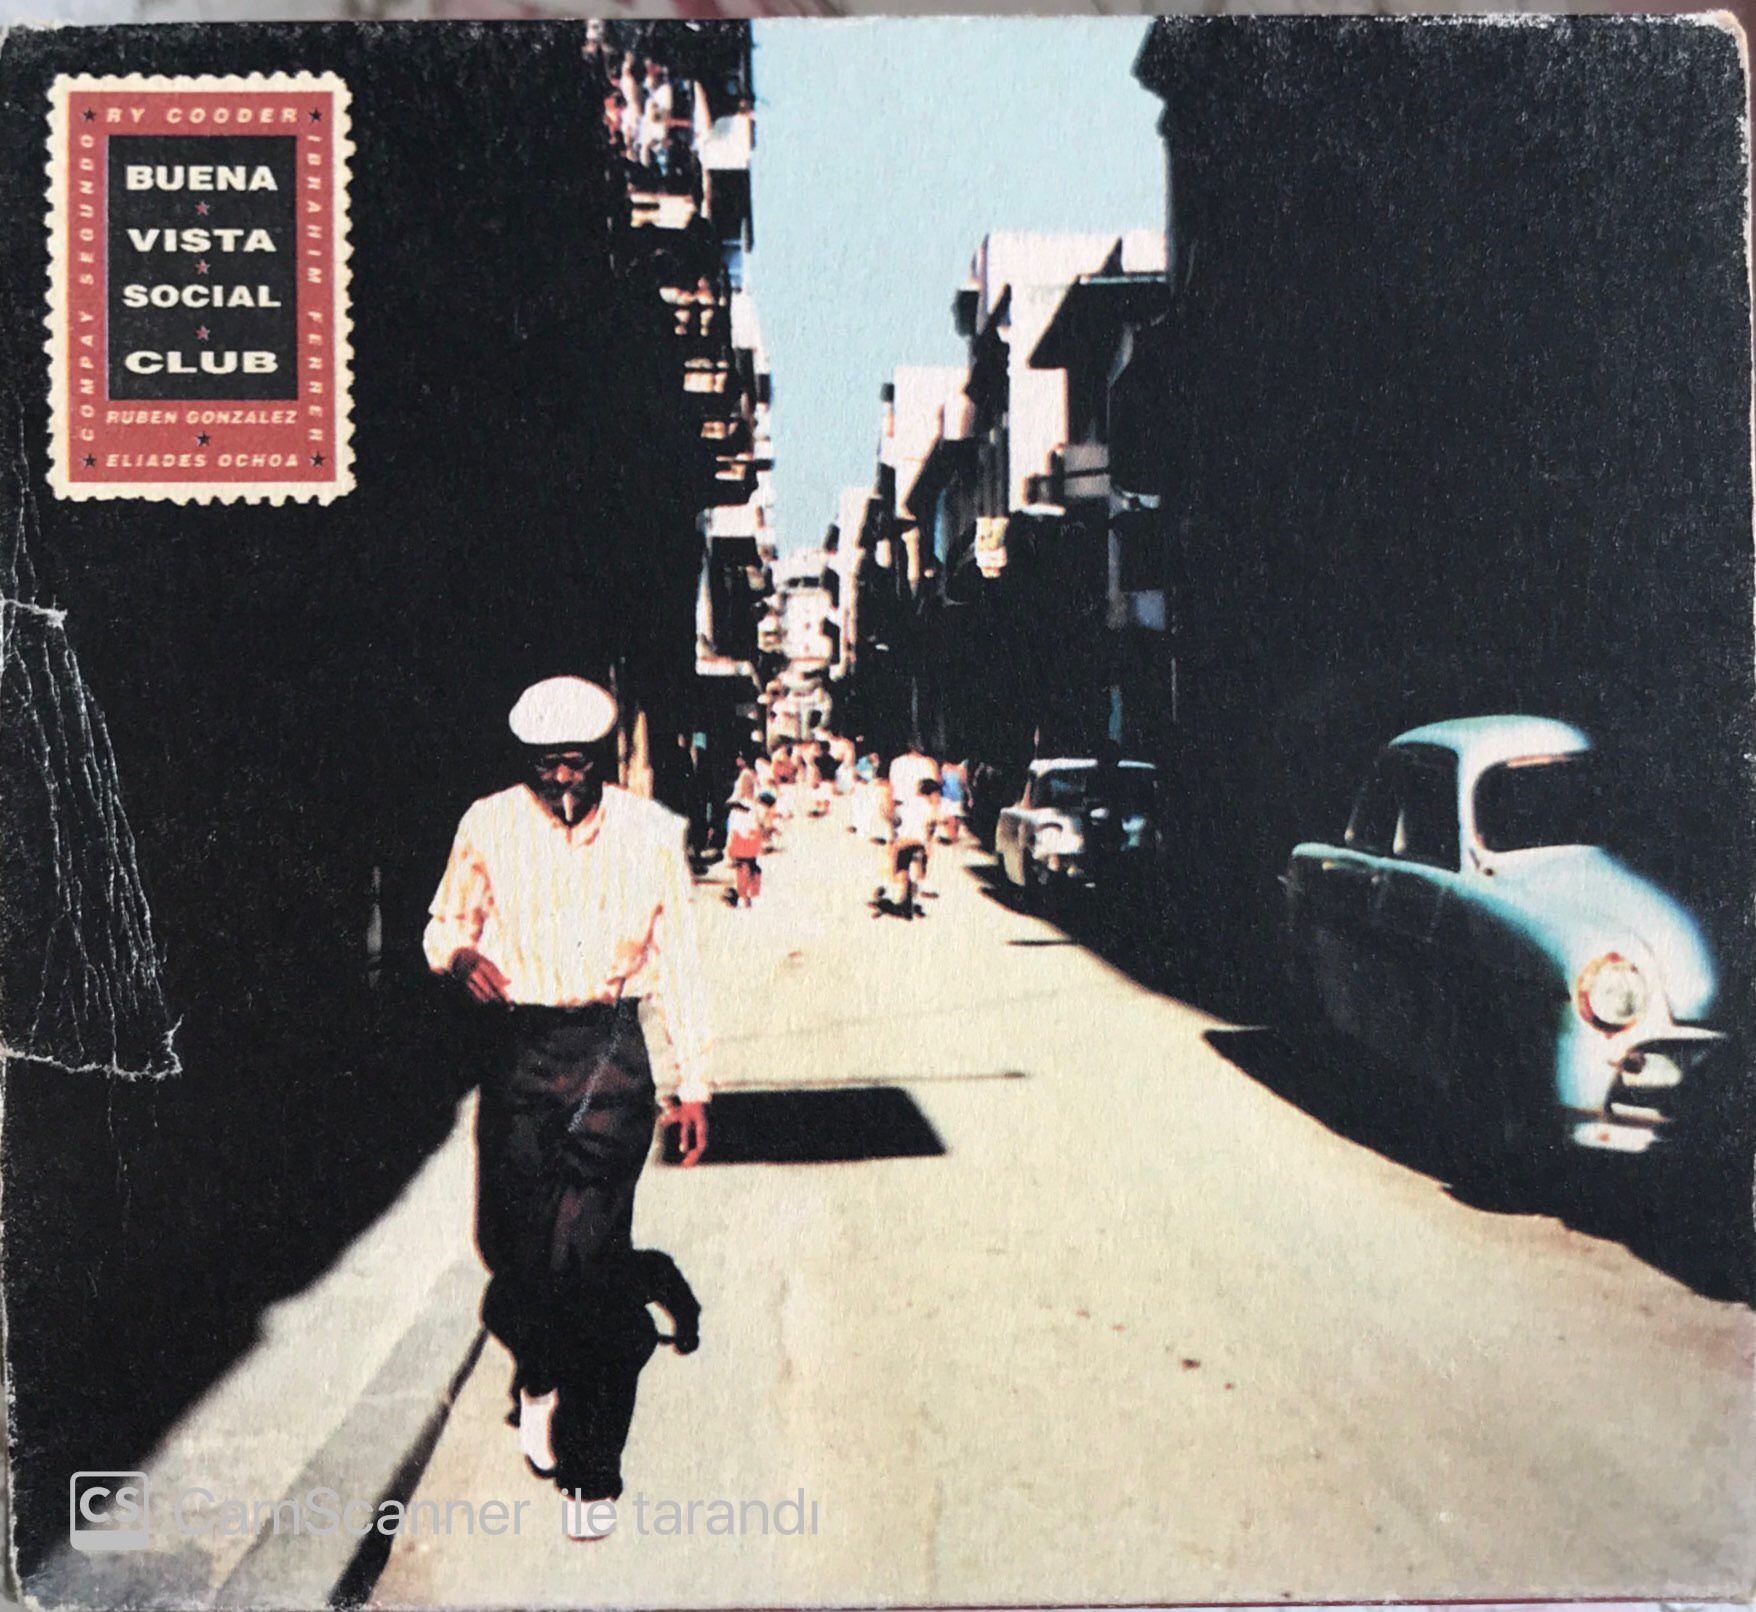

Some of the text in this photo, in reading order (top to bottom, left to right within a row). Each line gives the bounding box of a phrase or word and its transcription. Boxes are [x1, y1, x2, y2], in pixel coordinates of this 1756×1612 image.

[105, 106, 298, 124] RY COODER
[126, 165, 278, 191] BUENA
[126, 227, 277, 253] VISTA
[79, 133, 95, 442] COMPAY SEGUNDO
[122, 283, 282, 308] SOCIAL
[306, 134, 324, 442] IBRAHIM FERRER
[124, 350, 279, 375] CLUB
[105, 409, 298, 425] RUBEN GONZALEZ
[105, 453, 299, 468] ELIADES OCHOA
